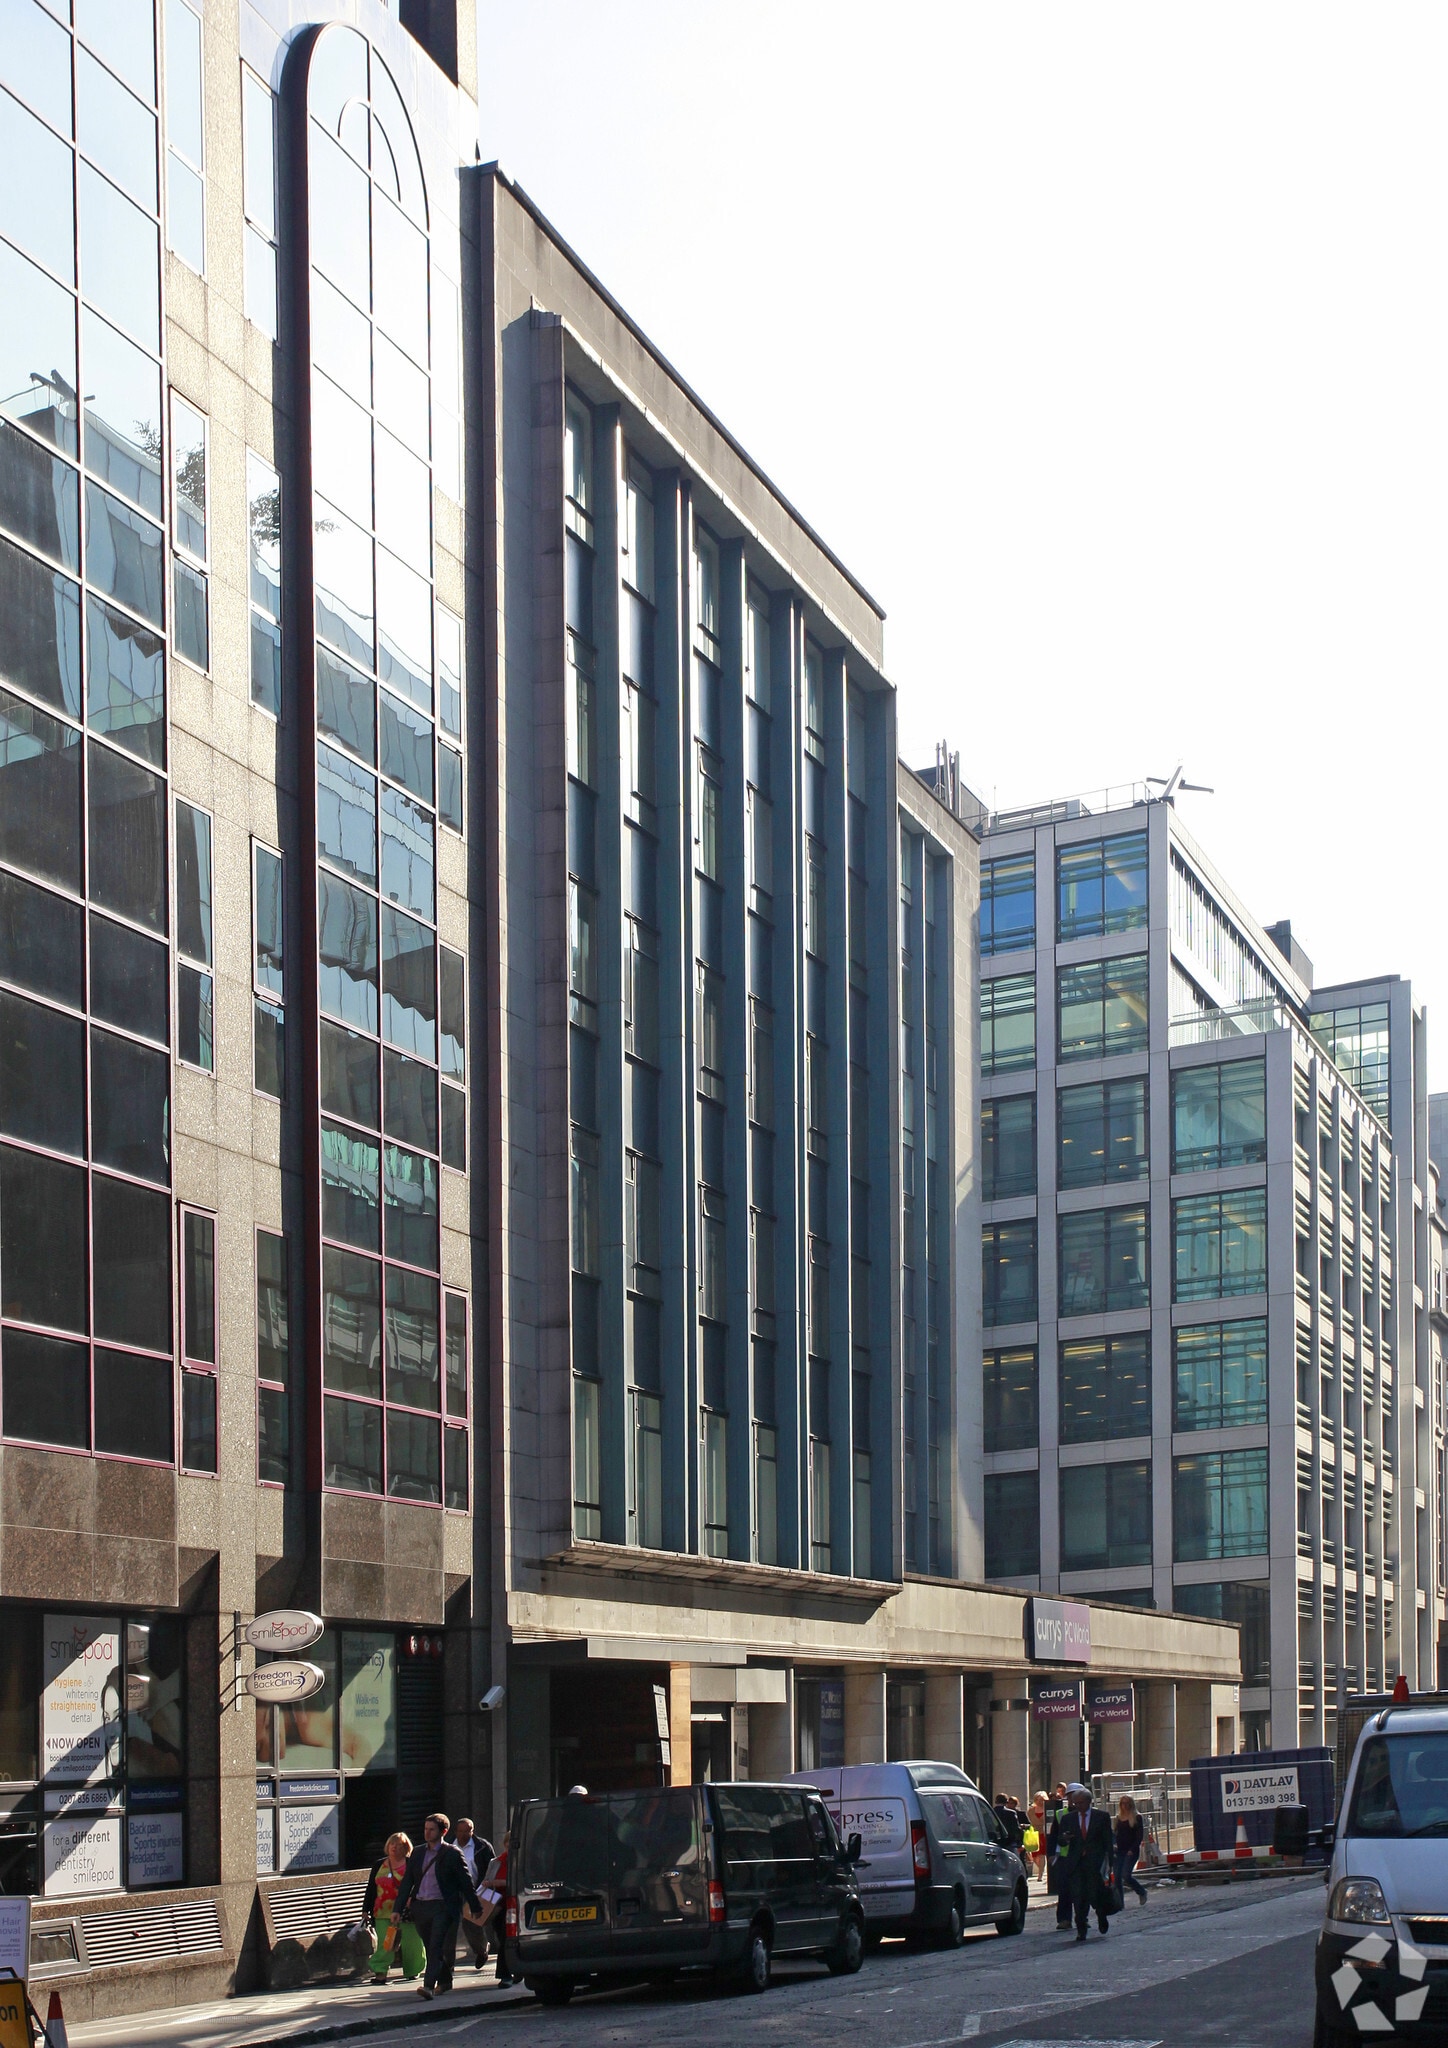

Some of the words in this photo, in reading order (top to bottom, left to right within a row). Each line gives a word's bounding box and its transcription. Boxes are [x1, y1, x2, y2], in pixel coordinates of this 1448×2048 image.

[252, 1623, 309, 1640] smilepod
[1036, 1618, 1062, 1649] currys
[1064, 1621, 1073, 1643] PC
[1073, 1622, 1090, 1645] World
[51, 1636, 113, 1666] smilepod
[254, 1671, 292, 1681] Freedom
[54, 1677, 82, 1689] hygiene
[66, 1689, 99, 1701] whitening
[355, 1693, 379, 1705] Walk-ins
[1040, 1689, 1074, 1699] currys
[1095, 1695, 1127, 1704] currys
[50, 1701, 96, 1712] straightening
[355, 1707, 380, 1718] welcome
[1038, 1705, 1050, 1713] PC
[1051, 1704, 1076, 1713] World
[1106, 1709, 1129, 1717] World
[71, 1713, 92, 1723] dental
[52, 1738, 75, 1749] NOW
[76, 1737, 100, 1749] OPEN
[49, 1753, 70, 1762] booking
[1243, 1775, 1294, 1790] DAVLAV
[59, 1794, 76, 1805] 0207
[77, 1793, 90, 1804] 836
[91, 1792, 108, 1803] 6866
[1226, 1796, 1255, 1808] 01375
[1257, 1794, 1275, 1805] 398
[1277, 1792, 1296, 1803] 398
[284, 1811, 300, 1824] Back
[300, 1809, 314, 1825] pain
[129, 1822, 146, 1836] Back
[146, 1821, 161, 1834] pain
[288, 1825, 310, 1841] Sports
[310, 1823, 332, 1839] injuries
[52, 1834, 64, 1847] for
[65, 1836, 70, 1845] a
[71, 1830, 111, 1845] different
[133, 1836, 156, 1852] Sports
[157, 1835, 181, 1850] injuries
[60, 1844, 77, 1857] kind
[78, 1844, 87, 1856] of
[284, 1839, 318, 1852] Headaches
[55, 1857, 96, 1871] dentistry
[128, 1850, 166, 1865] Headaches
[289, 1852, 314, 1866] Trapped
[314, 1852, 335, 1864] nerves
[73, 1867, 115, 1884] smilepod
[532, 1881, 564, 1889] TRANSIT
[541, 1910, 569, 1921] LY60
[571, 1908, 592, 1920] CGF
[2, 1917, 20, 1926] Hair
